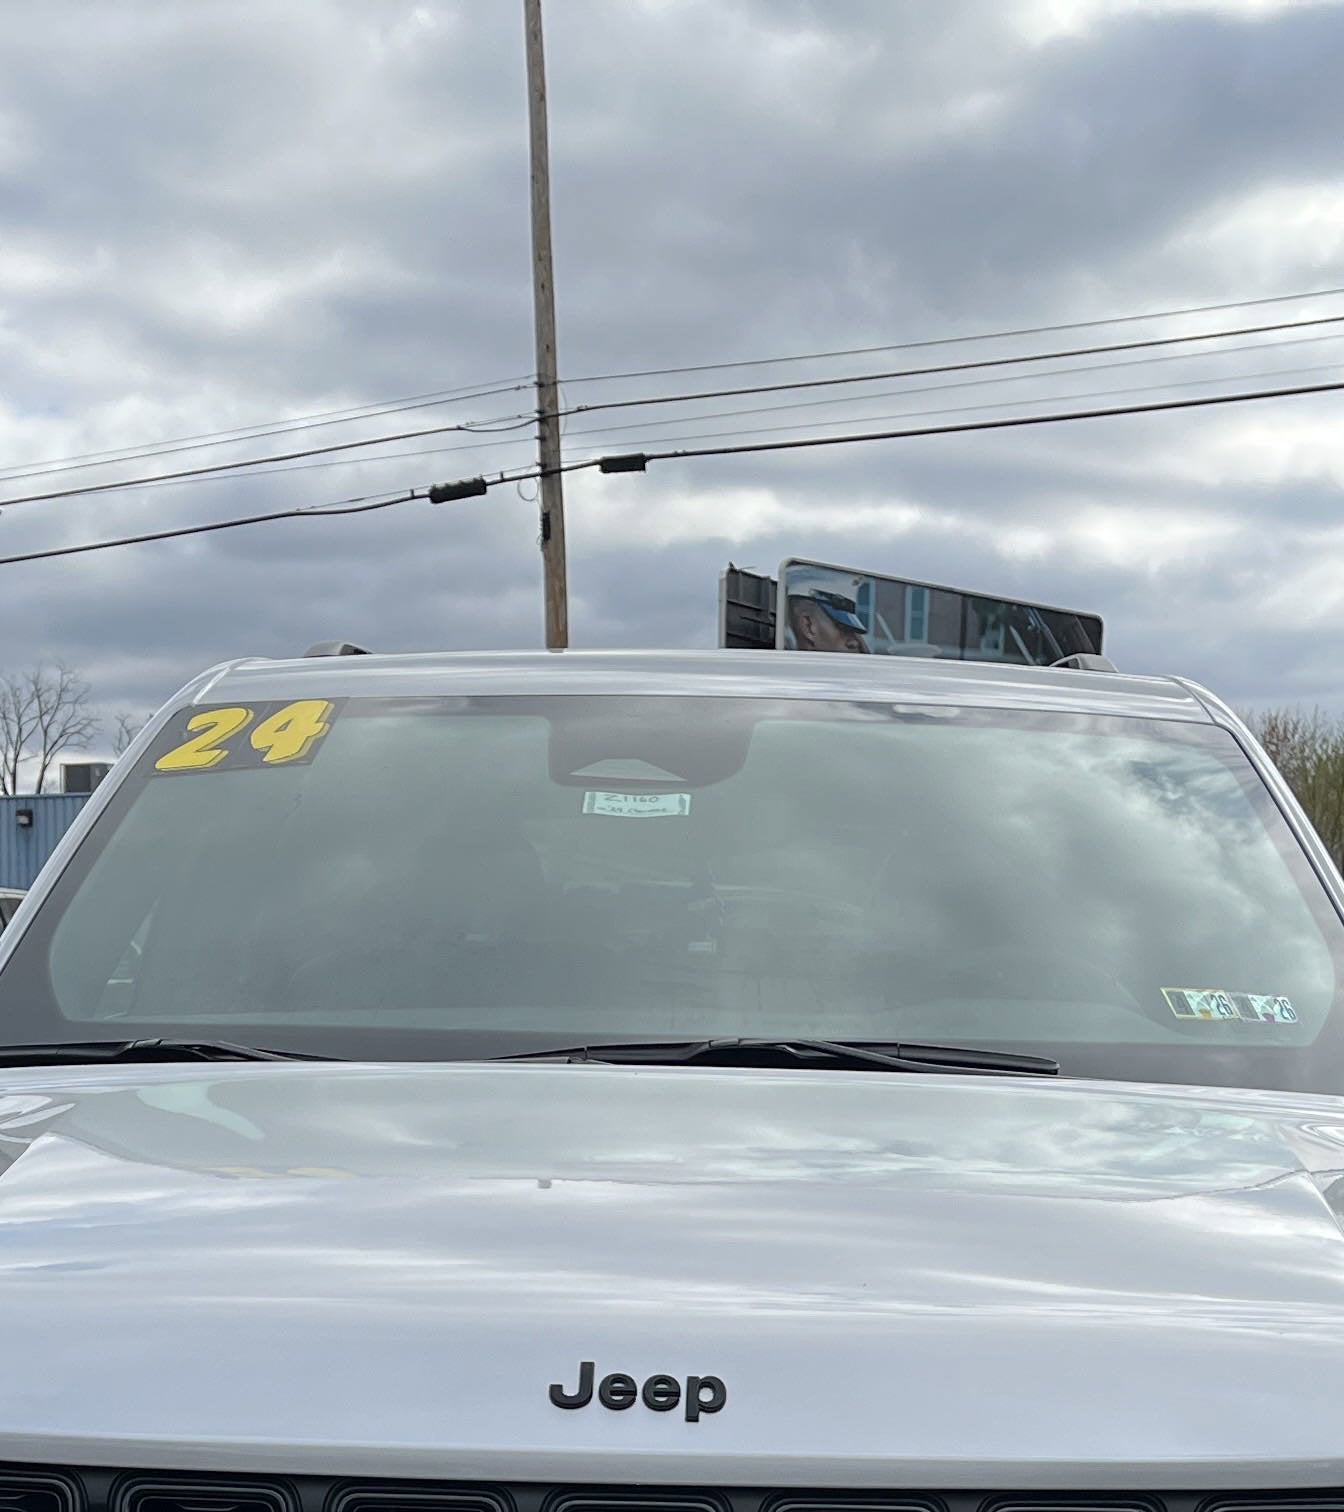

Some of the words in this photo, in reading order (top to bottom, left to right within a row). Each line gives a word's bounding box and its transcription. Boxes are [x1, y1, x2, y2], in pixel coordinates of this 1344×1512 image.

[154, 699, 335, 772] 24
[1210, 994, 1234, 1017] 26
[1274, 998, 1298, 1021] 26
[549, 1361, 727, 1422] Jeep
